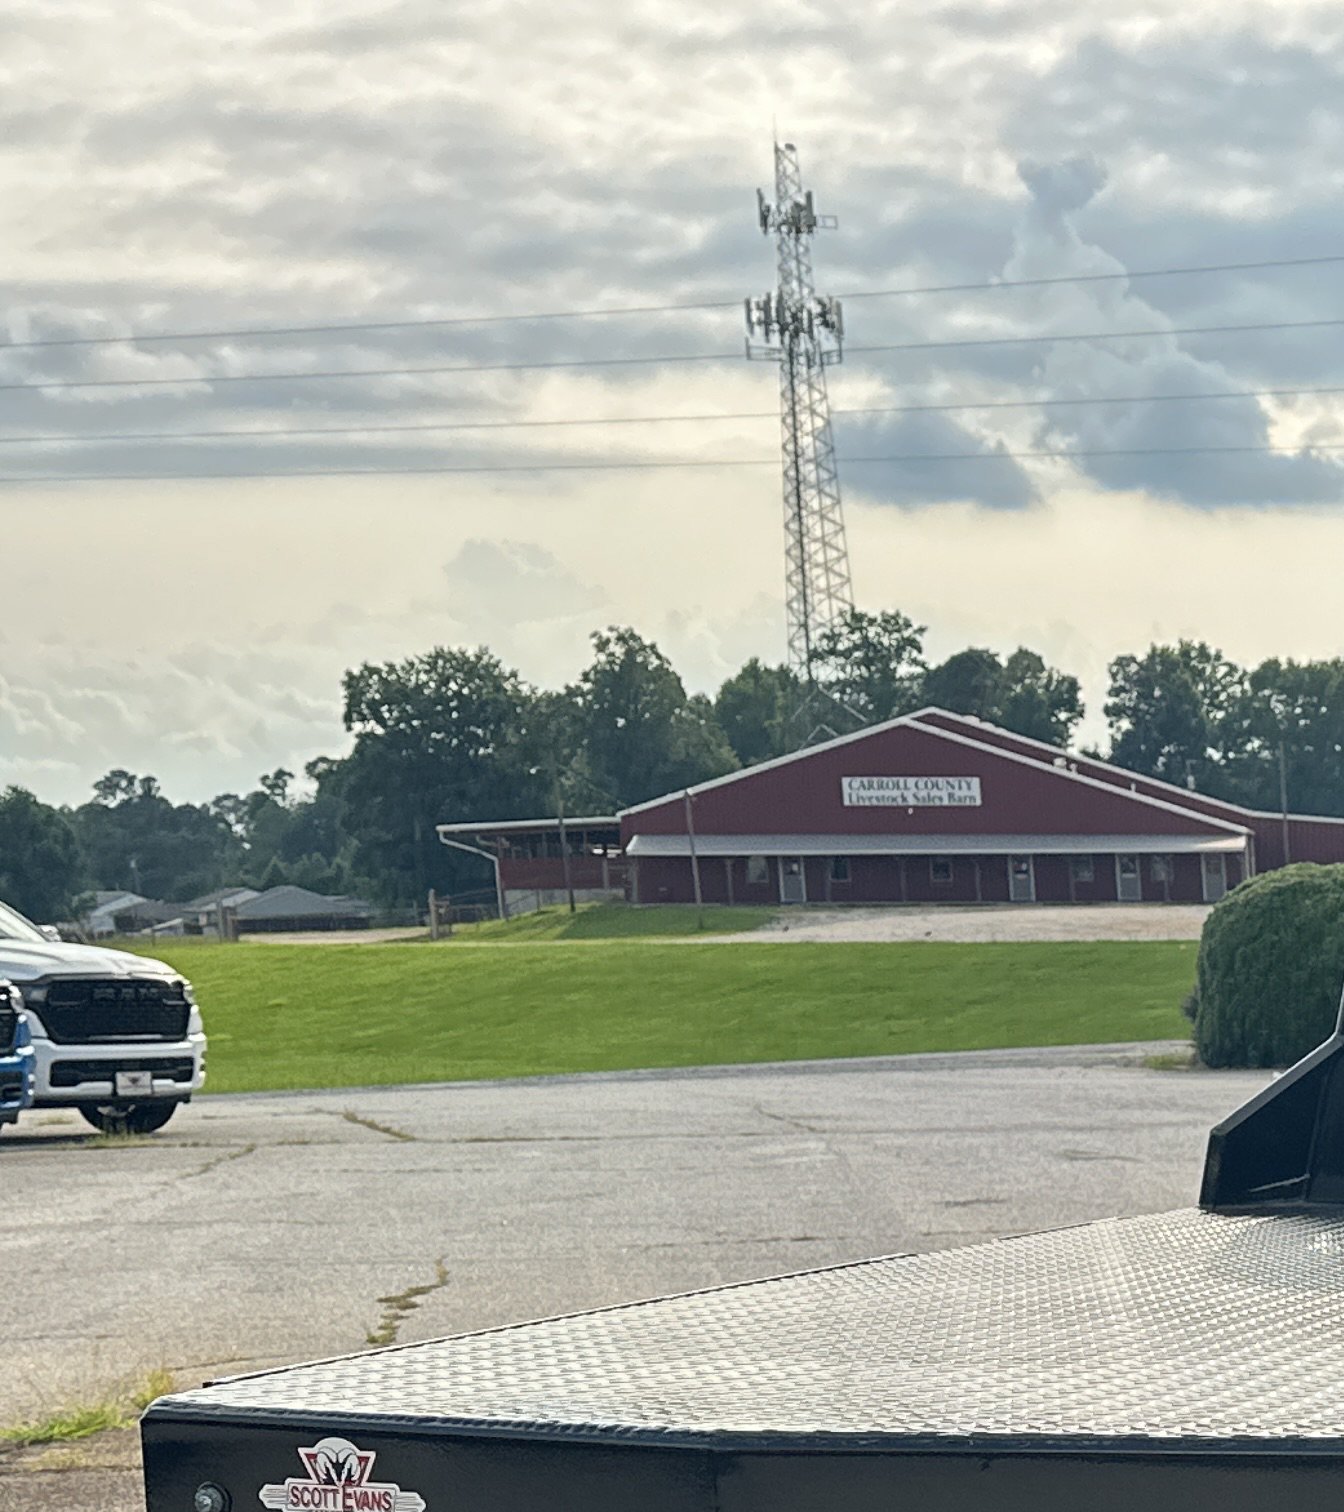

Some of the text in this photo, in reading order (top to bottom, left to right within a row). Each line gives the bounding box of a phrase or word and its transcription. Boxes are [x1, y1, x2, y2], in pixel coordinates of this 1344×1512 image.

[848, 778, 973, 791] CARROLL COUNTY
[849, 792, 977, 804] Livestock Sales Barn
[290, 1480, 393, 1512] SCOTT EVANS
